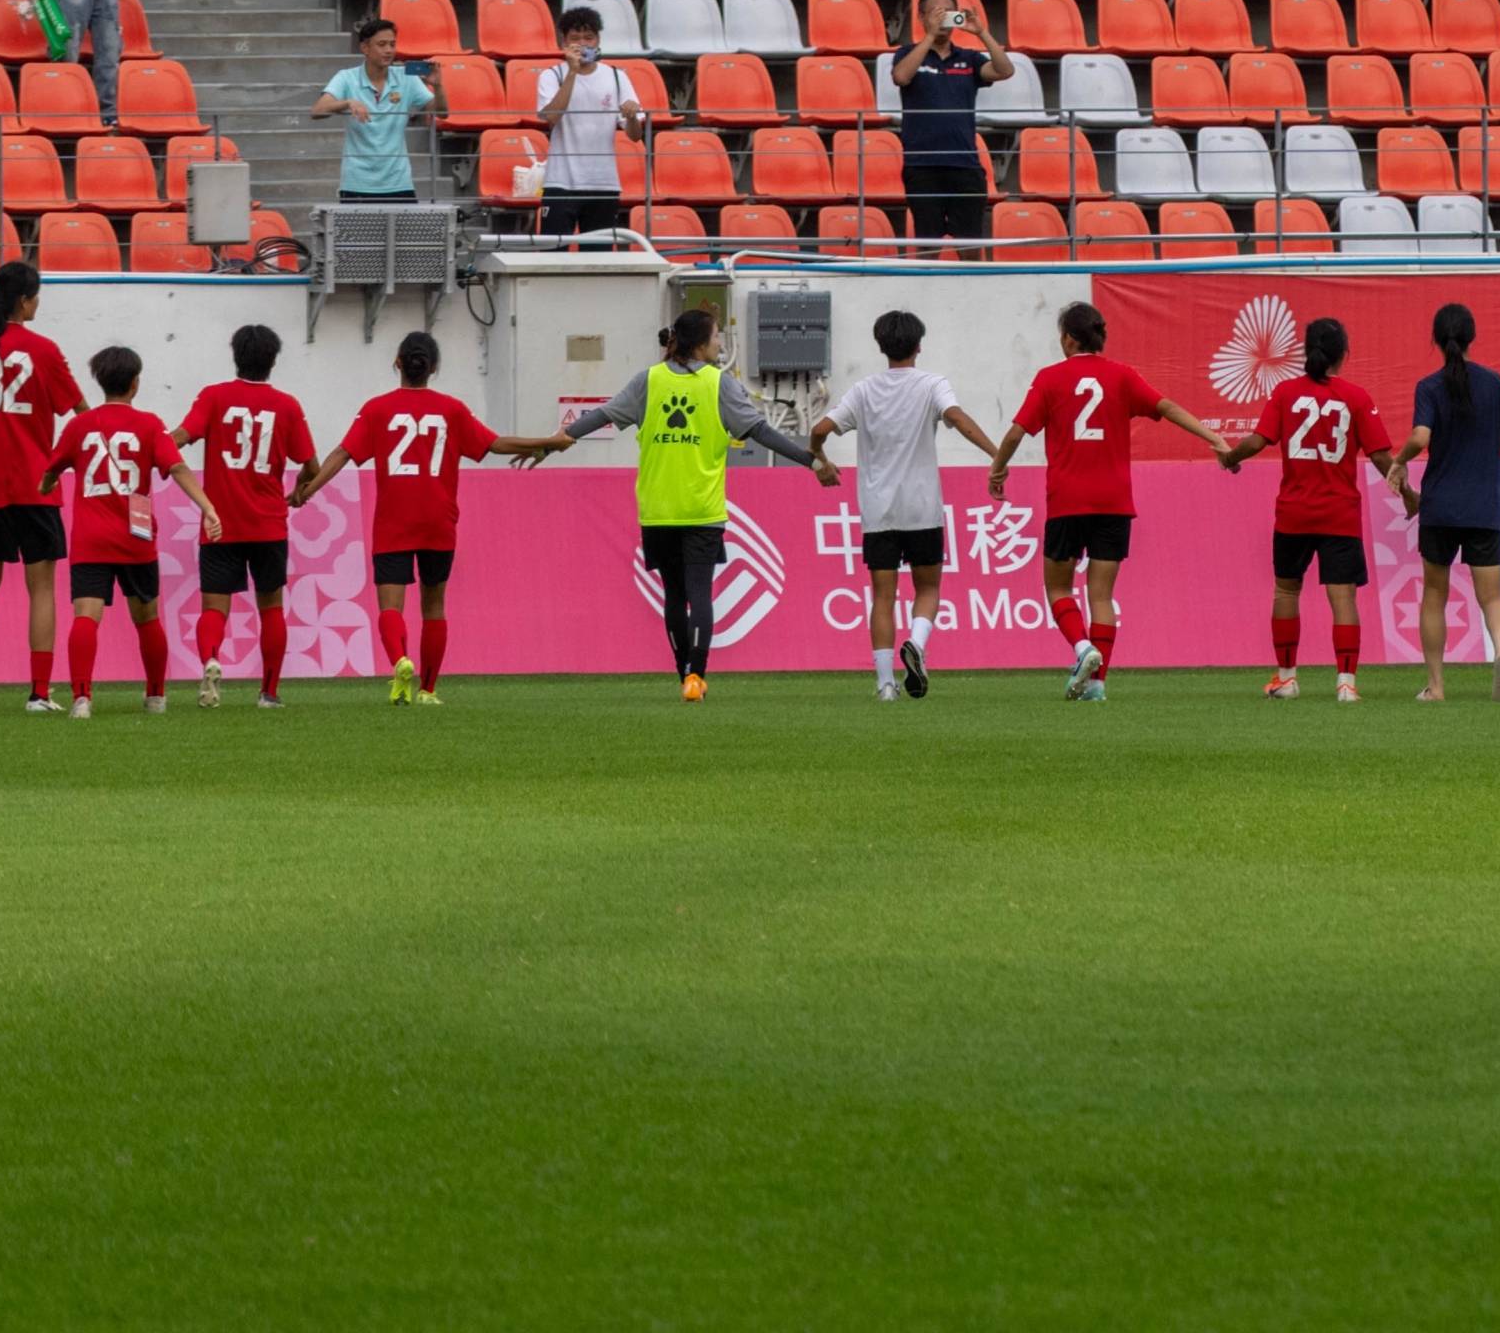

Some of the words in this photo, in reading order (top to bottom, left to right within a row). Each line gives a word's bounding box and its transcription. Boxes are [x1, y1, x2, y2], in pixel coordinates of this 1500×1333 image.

[221, 406, 276, 475] 31
[652, 433, 701, 445] KELME
[1074, 377, 1104, 441] 2
[1287, 396, 1351, 464] 23
[81, 431, 140, 497] 26
[388, 413, 447, 477] 27
